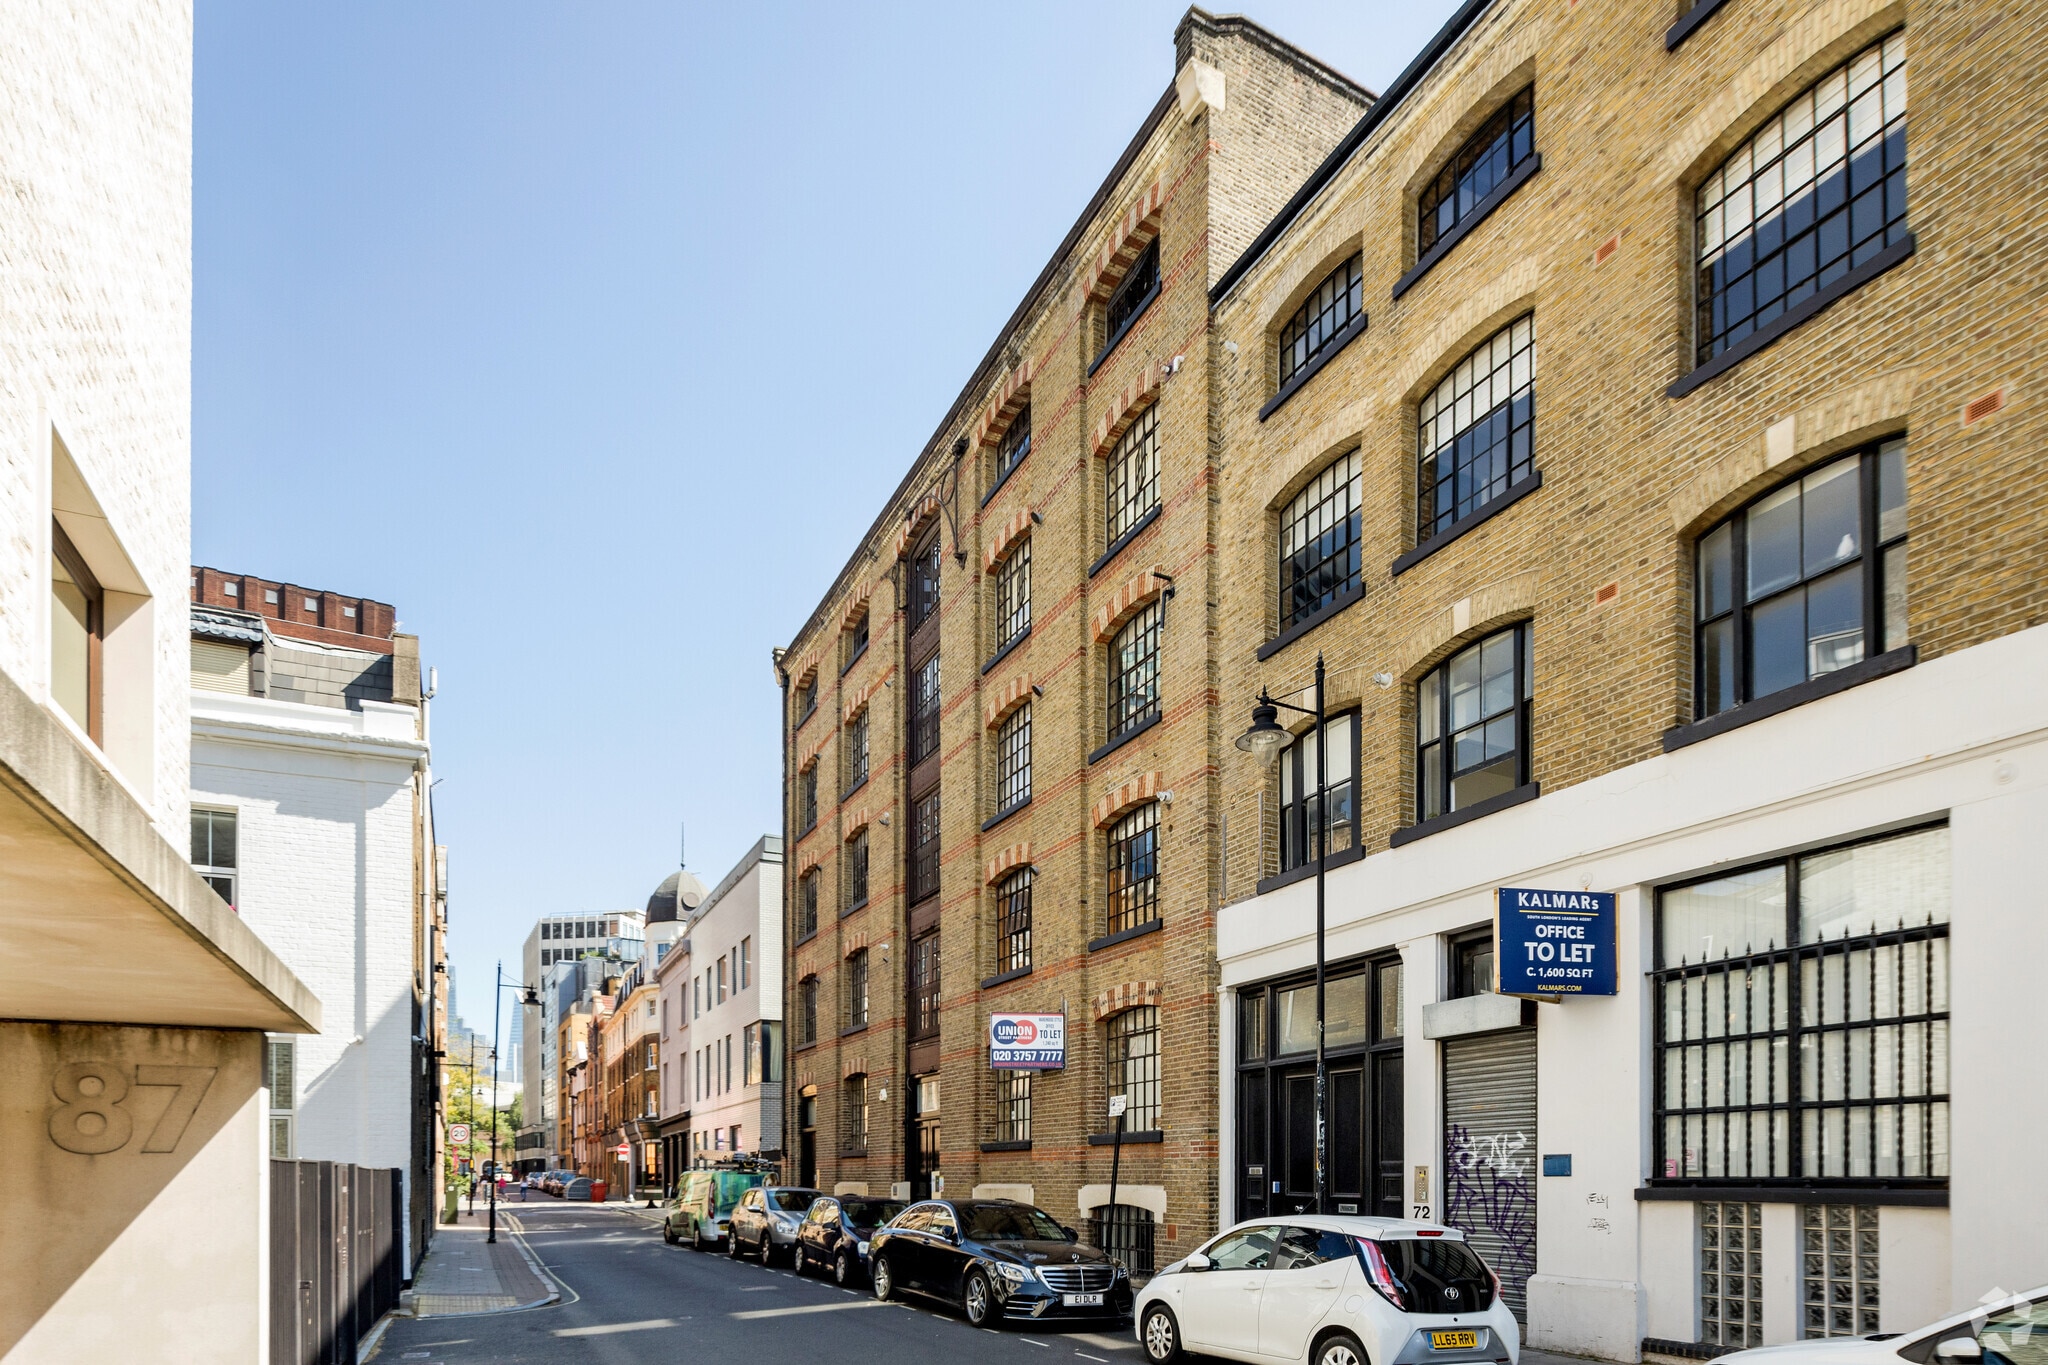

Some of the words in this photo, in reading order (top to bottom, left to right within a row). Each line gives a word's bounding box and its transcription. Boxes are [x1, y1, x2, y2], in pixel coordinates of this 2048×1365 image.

[1535, 925, 1585, 939] OFFICE
[1524, 942, 1555, 961] TO
[1560, 943, 1595, 963] LET
[1526, 967, 1536, 977] C.
[1538, 968, 1565, 978] 1,600
[1566, 968, 1581, 978] SQ
[1582, 969, 1594, 978] FT
[1537, 984, 1582, 992] KALMARS.COM
[998, 1025, 1032, 1036] UNION
[1040, 1029, 1048, 1039] TO
[1049, 1029, 1061, 1039] LET
[993, 1051, 1011, 1061] 020
[1013, 1051, 1037, 1061] 3757
[1039, 1051, 1063, 1061] 7777
[48, 1061, 218, 1155] 87
[1413, 1206, 1430, 1219] 72
[1083, 1295, 1097, 1303] DLR
[1432, 1332, 1456, 1346] LL65
[1458, 1332, 1475, 1345] RRV
